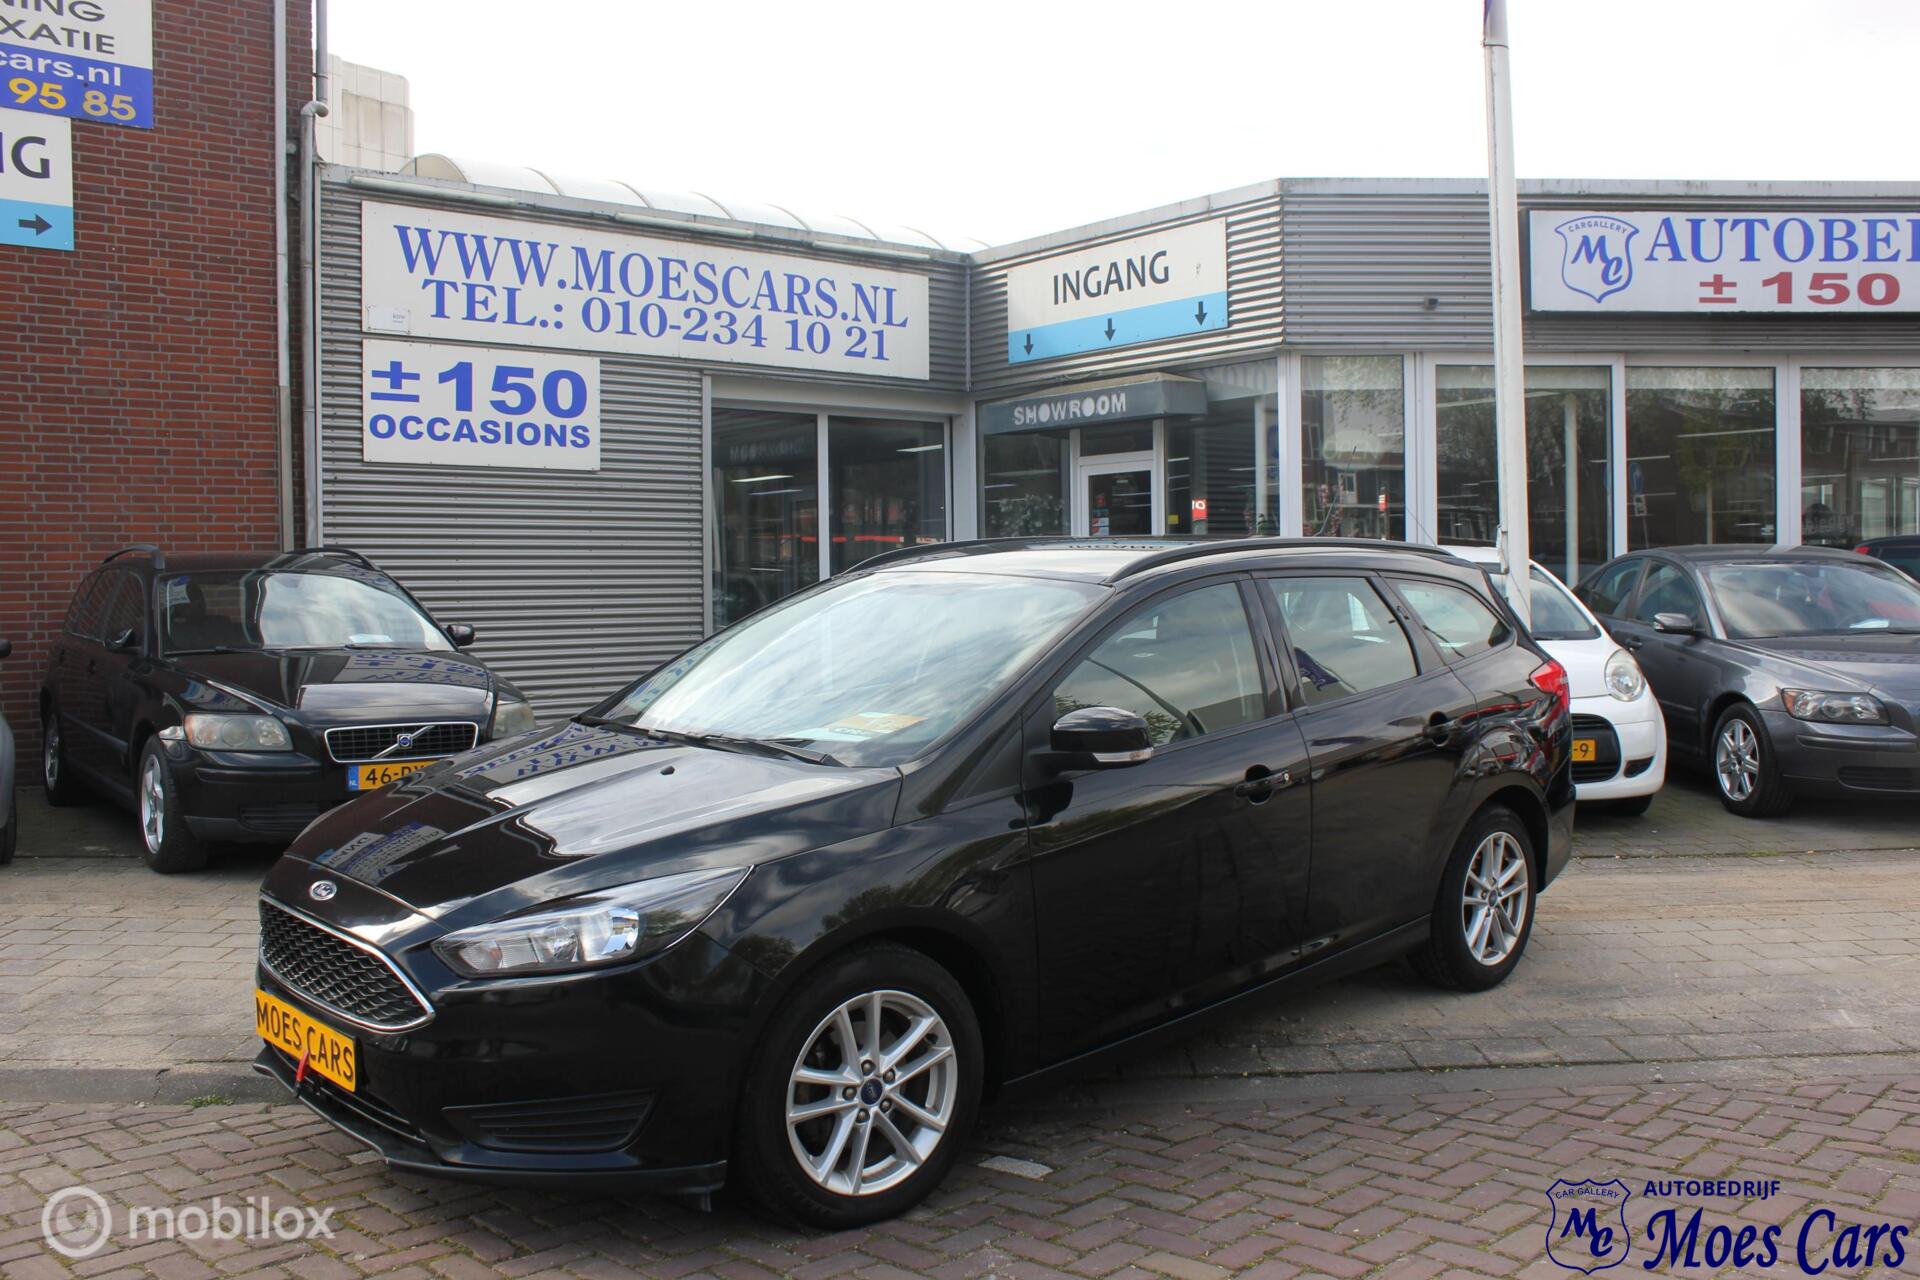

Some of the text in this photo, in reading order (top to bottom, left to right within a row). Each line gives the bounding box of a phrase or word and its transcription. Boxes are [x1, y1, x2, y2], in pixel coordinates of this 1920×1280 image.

[0, 0, 105, 22] ING
[0, 15, 115, 55] XATIE
[8, 77, 137, 121] 95 85
[0, 131, 50, 179] G
[393, 224, 909, 328] WWW.MOESCARS.NL
[1053, 250, 1169, 305] INGANG
[1761, 271, 1901, 306] 150
[581, 296, 768, 348] 010-234
[785, 318, 831, 355] 10
[844, 325, 890, 361] 21
[438, 361, 588, 419] 150
[1013, 392, 1127, 426] SHOWROOM
[369, 413, 591, 449] OCCASIONS
[256, 997, 354, 1081] MOES CARS
